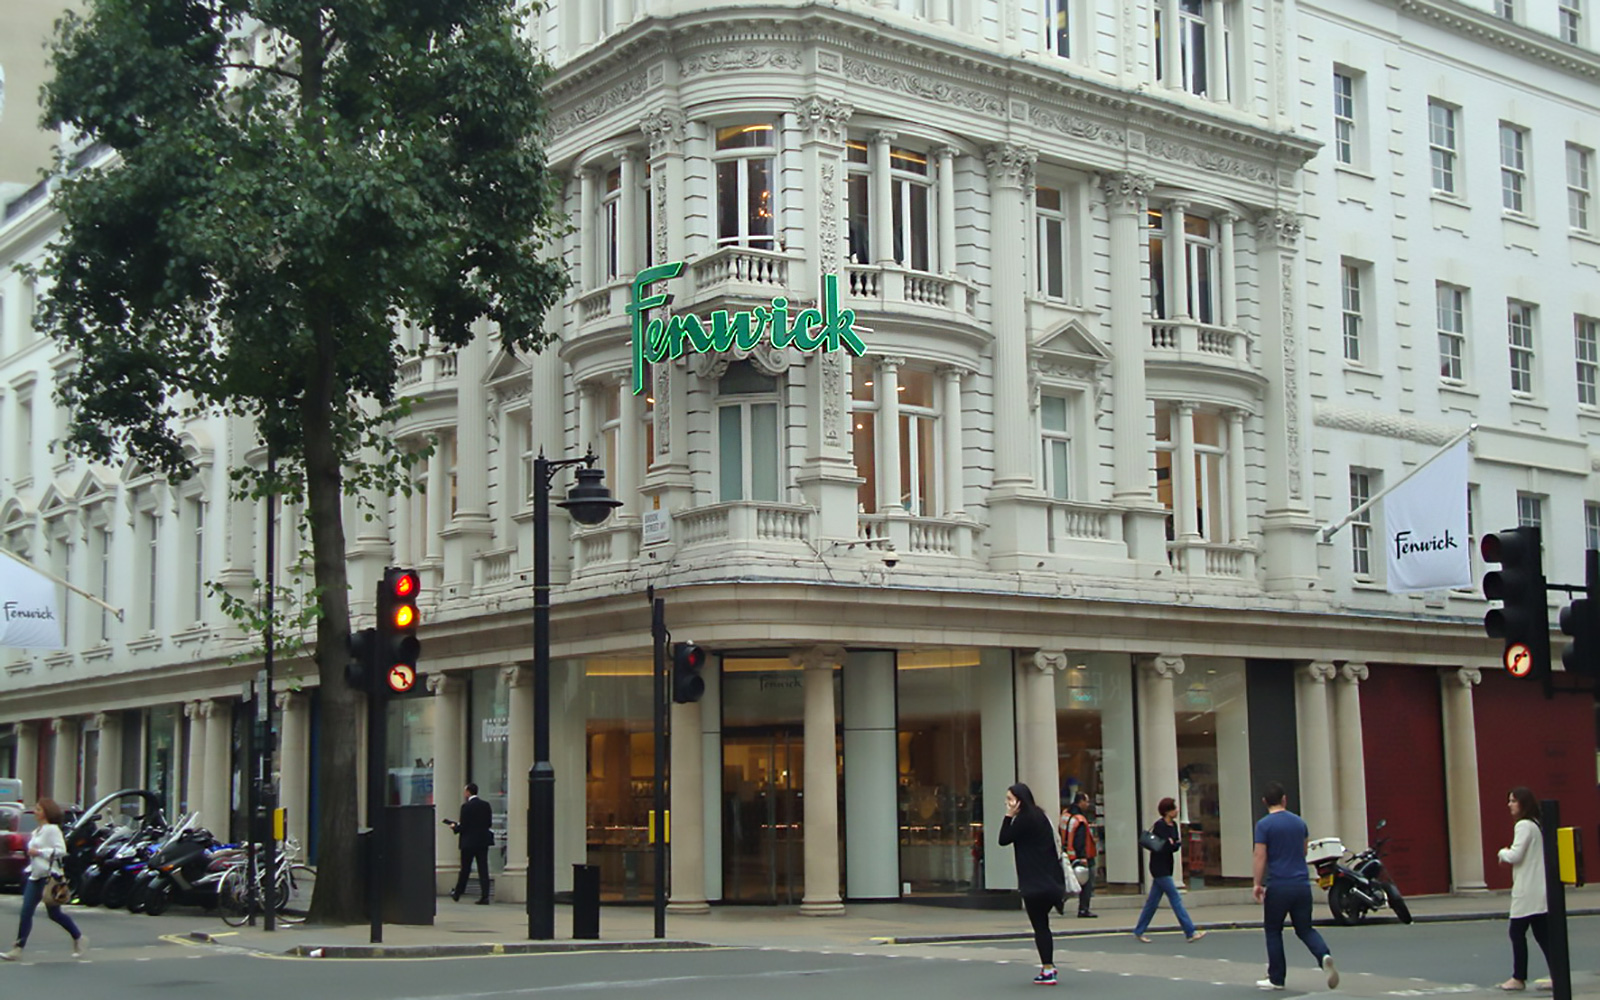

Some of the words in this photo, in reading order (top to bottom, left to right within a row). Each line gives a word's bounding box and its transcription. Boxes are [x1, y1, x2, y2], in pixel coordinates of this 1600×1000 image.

[625, 260, 867, 396] Fenwick
[1394, 529, 1458, 560] Fenwick
[3, 601, 55, 621] Fenwick
